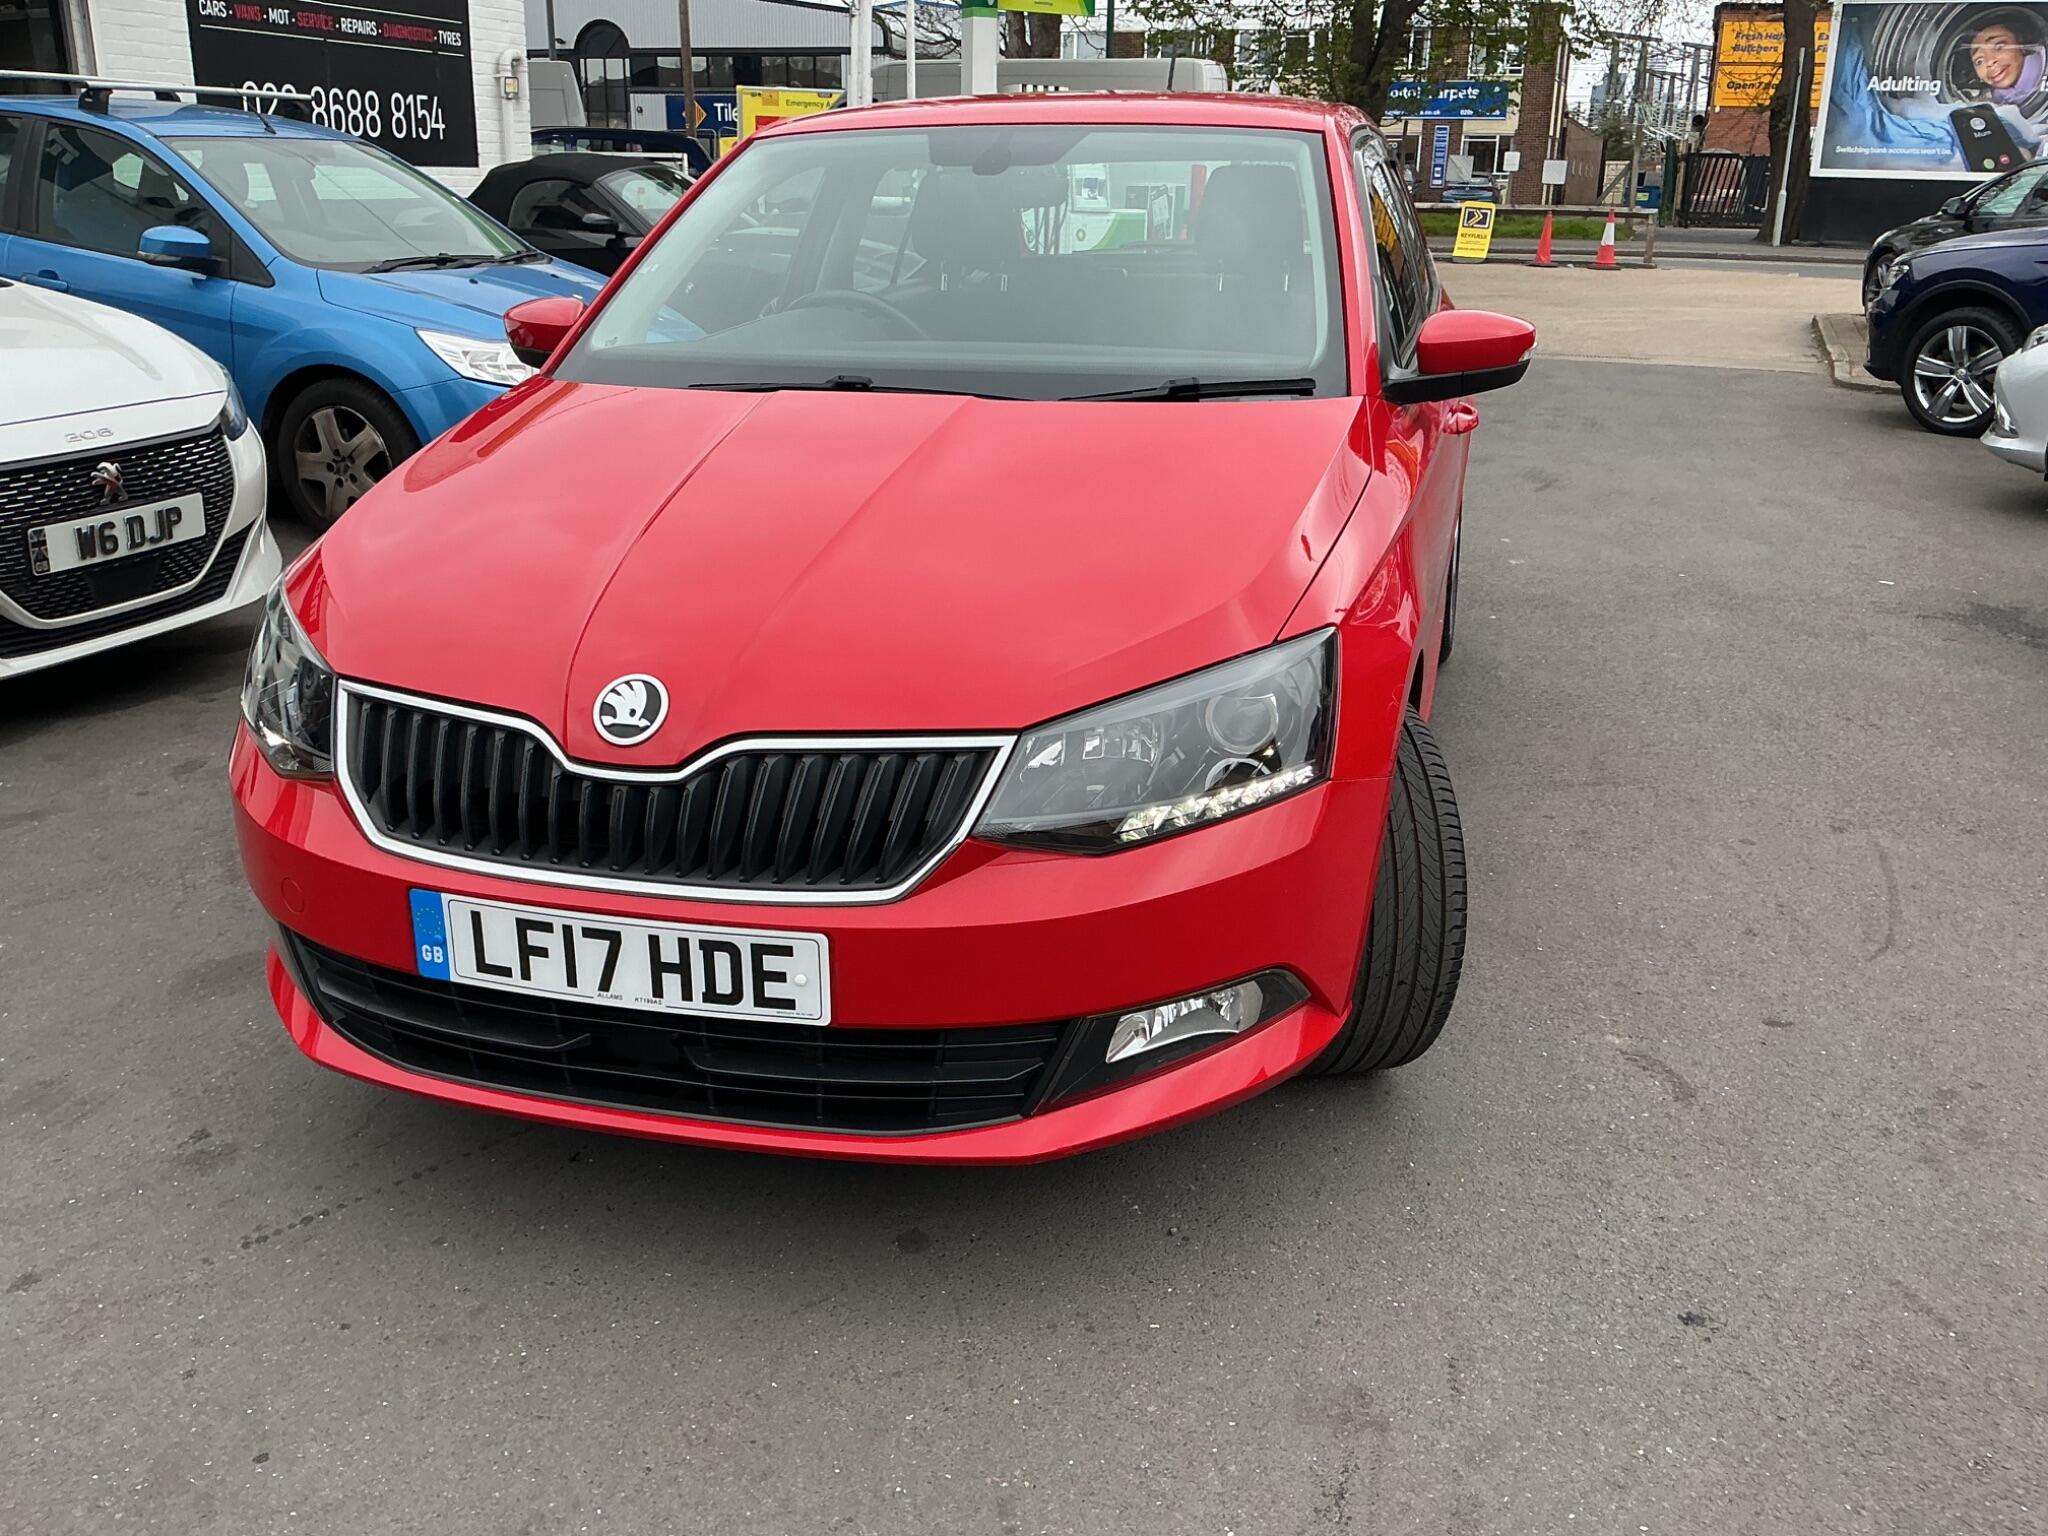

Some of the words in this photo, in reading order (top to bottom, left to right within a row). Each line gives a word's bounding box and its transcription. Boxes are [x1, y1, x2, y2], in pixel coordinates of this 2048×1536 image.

[199, 0, 227, 18] CARS
[234, 4, 262, 22] VANS
[268, 8, 290, 25] MOT
[297, 11, 334, 31] SERVICE
[341, 16, 377, 36] REPAIRS
[383, 22, 433, 42] DIAGNOSTICS
[438, 30, 462, 47] TYRES
[1734, 32, 1764, 41] Fresh
[1726, 81, 1755, 91] Open
[1866, 76, 1942, 96] Adulting
[310, 85, 382, 138] 8688
[390, 92, 446, 140] 8154
[785, 99, 825, 108] Emergency
[1973, 130, 1993, 139] Mum
[1835, 145, 1869, 155] Switching
[1870, 146, 1887, 154] bank
[74, 520, 119, 561] W6
[124, 506, 183, 550] DJP
[421, 944, 444, 964] GB
[470, 910, 623, 993] LF17
[648, 934, 797, 1011] HDE
